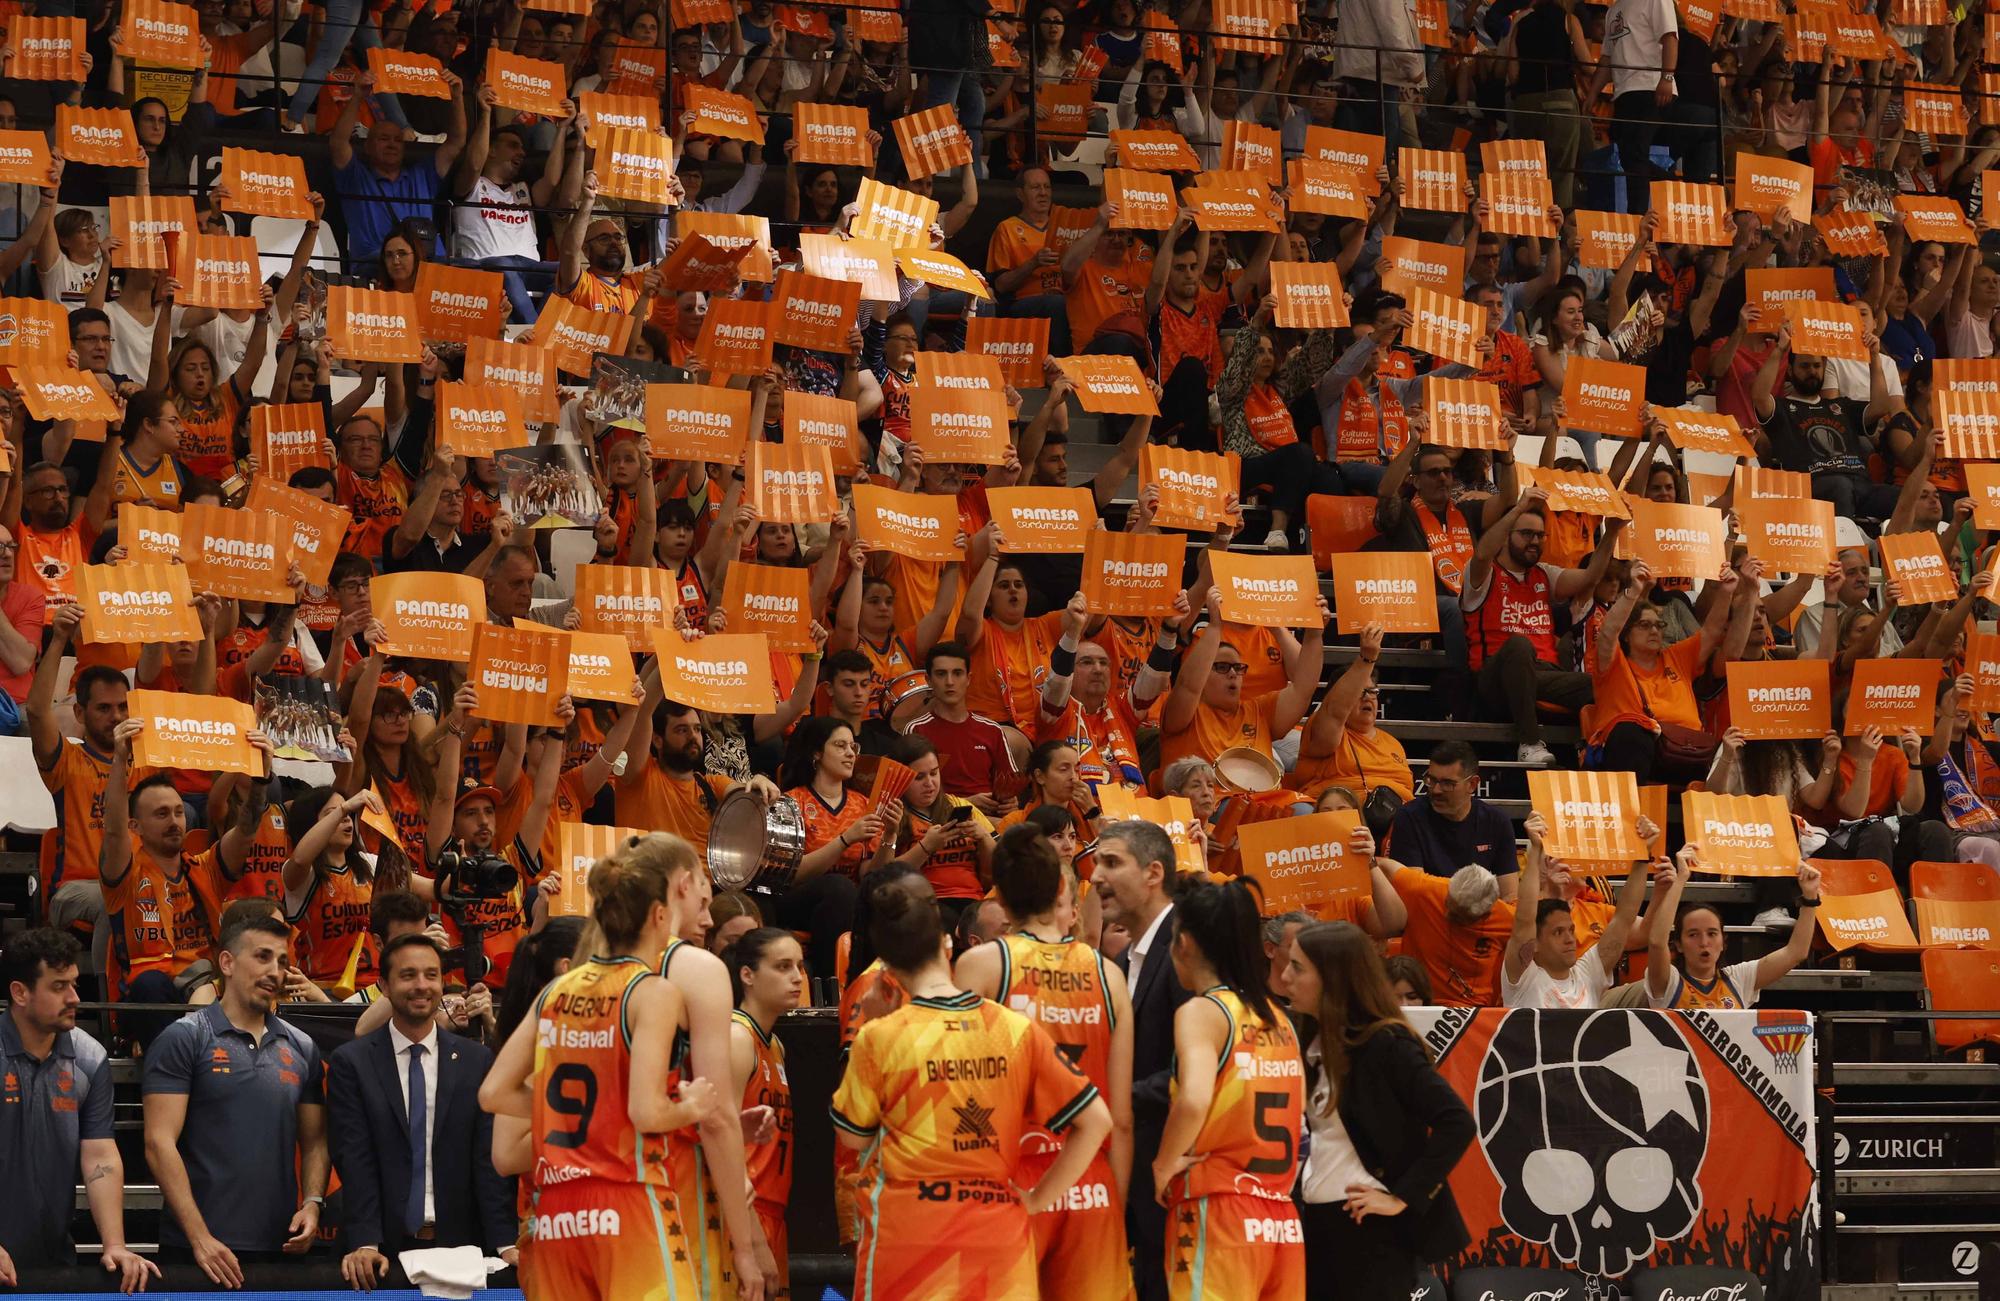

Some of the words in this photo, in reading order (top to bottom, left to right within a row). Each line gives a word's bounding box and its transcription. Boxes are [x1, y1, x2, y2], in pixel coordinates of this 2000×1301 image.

[135, 18, 189, 37] PAMESA
[22, 38, 72, 51] PAMESA
[385, 63, 439, 77] PAMESA
[501, 70, 551, 89] PAMESA
[596, 112, 647, 128] PAMESA
[806, 123, 857, 137] PAMESA
[913, 123, 960, 147] PAMESA
[1234, 141, 1273, 158] PAMESA
[1320, 148, 1369, 165] PAMESA
[611, 151, 666, 169] PAMESA
[1498, 159, 1541, 170] PAMESA
[240, 169, 294, 188] PAMESA
[1412, 169, 1456, 183] PAMESA
[1751, 173, 1800, 191] PAMESA
[1122, 188, 1168, 203] PAMESA
[871, 202, 923, 229] PAMESA
[1667, 202, 1713, 216] PAMESA
[1591, 230, 1636, 243] PAMESA
[195, 258, 251, 274] PAMESA
[820, 255, 878, 271] PAMESA
[911, 256, 965, 277] PAMESA
[1397, 257, 1448, 275] PAMESA
[1286, 284, 1331, 297] PAMESA
[1763, 289, 1817, 301] PAMESA
[430, 290, 488, 311] PAMESA
[786, 296, 842, 318] PAMESA
[347, 312, 406, 329] PAMESA
[1803, 317, 1853, 332] PAMESA
[20, 325, 50, 337] basket
[20, 334, 41, 345] club
[554, 320, 610, 348] PAMESA
[714, 323, 765, 341] PAMESA
[983, 341, 1034, 355] PAMESA
[484, 364, 544, 386] PAMESA
[935, 376, 990, 390] PAMESA
[1087, 381, 1140, 395] PAMESA
[1580, 383, 1631, 401] PAMESA
[1950, 380, 1998, 393] PAMESA
[450, 407, 507, 424] PAMESA
[1437, 400, 1491, 417] PAMESA
[666, 408, 732, 428] PAMESA
[931, 412, 992, 429] PAMESA
[269, 430, 316, 444] PAMESA
[798, 419, 847, 438] PAMESA
[1341, 429, 1368, 440] Cultura
[1339, 435, 1375, 445] Esfuerzo
[764, 469, 824, 486] PAMESA
[1159, 467, 1217, 489] PAMESA
[876, 506, 940, 529] PAMESA
[1012, 507, 1079, 520] PAMESA
[1654, 528, 1711, 544] PAMESA
[1766, 522, 1823, 538] PAMESA
[203, 535, 274, 560] PAMESA
[1103, 560, 1168, 578] PAMESA
[1232, 576, 1298, 592] PAMESA
[1355, 579, 1417, 594] PAMESA
[99, 590, 172, 605] PAMESA
[594, 594, 661, 611] PAMESA
[744, 593, 798, 613] PAMESA
[395, 599, 469, 619] PAMESA
[675, 656, 748, 675] PAMESA
[482, 669, 548, 694] PAMESA
[1748, 686, 1812, 701] PAMESA
[1865, 685, 1920, 699] PAMESA
[154, 716, 237, 736] PAMESA
[1554, 800, 1621, 818] PAMESA
[1704, 820, 1775, 837] PAMESA
[248, 844, 286, 857] ultura
[1265, 841, 1344, 868] PAMESA
[321, 900, 370, 920] Cultur
[1828, 915, 1887, 931] PAMESA
[1931, 926, 1991, 941] PAMESA
[1846, 961, 1853, 970] 3
[553, 992, 618, 1018] QUERALT
[1040, 1002, 1101, 1025] isaval
[561, 1025, 614, 1049] isaval
[1756, 1026, 1786, 1034] VALENCIA
[1974, 1050, 1981, 1061] 2
[927, 1055, 1008, 1083] BUENAVIDA
[544, 1063, 599, 1150] 9
[1245, 1091, 1292, 1174] 5
[1858, 1139, 1943, 1158] ZURICH
